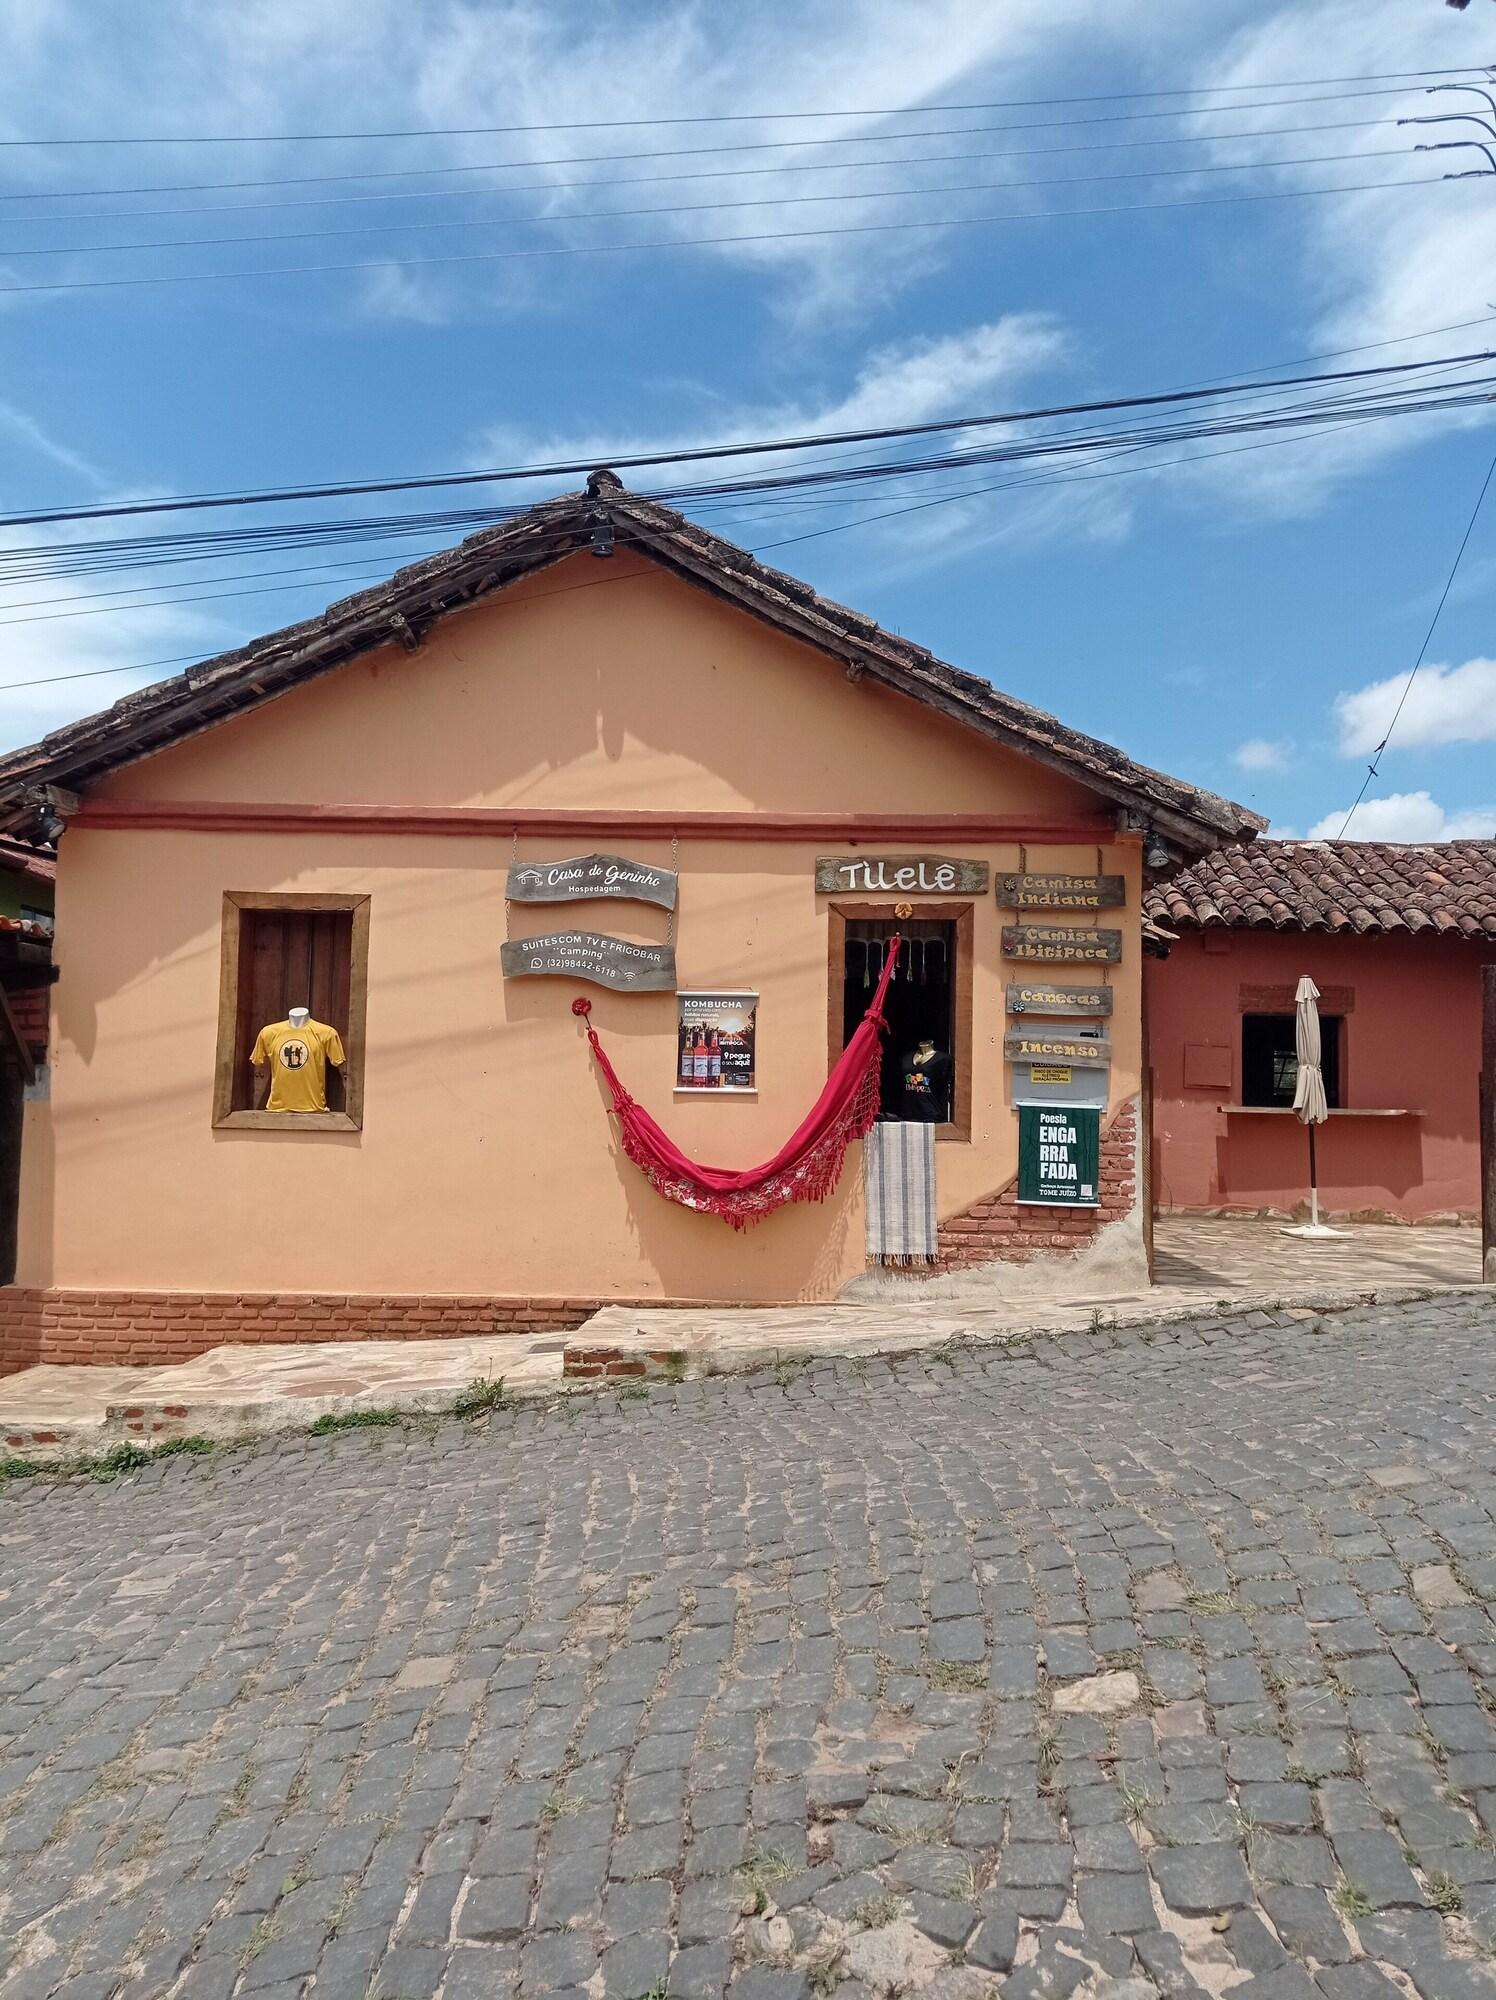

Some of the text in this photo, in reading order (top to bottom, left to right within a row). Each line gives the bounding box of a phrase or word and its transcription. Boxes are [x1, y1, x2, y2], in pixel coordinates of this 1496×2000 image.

[547, 864, 661, 887] Casa do Geninho
[1022, 876, 1097, 889] Camisa
[568, 885, 621, 894] Hospedagem
[1017, 892, 1100, 906] Indiana
[1026, 928, 1099, 942] Camisa
[585, 936, 599, 946] TV
[600, 940, 608, 949] E
[609, 942, 661, 963] FRIGOBAR
[684, 1000, 742, 1009] KOMBUCHA
[1020, 989, 1100, 1005] Canecas
[729, 1052, 751, 1060] pegue
[1020, 1040, 1098, 1057] Incenso
[1040, 1113, 1067, 1124] Poesia
[1040, 1126, 1077, 1144] ENGA
[1040, 1145, 1069, 1162] RRA
[1040, 1162, 1078, 1180] FADA
